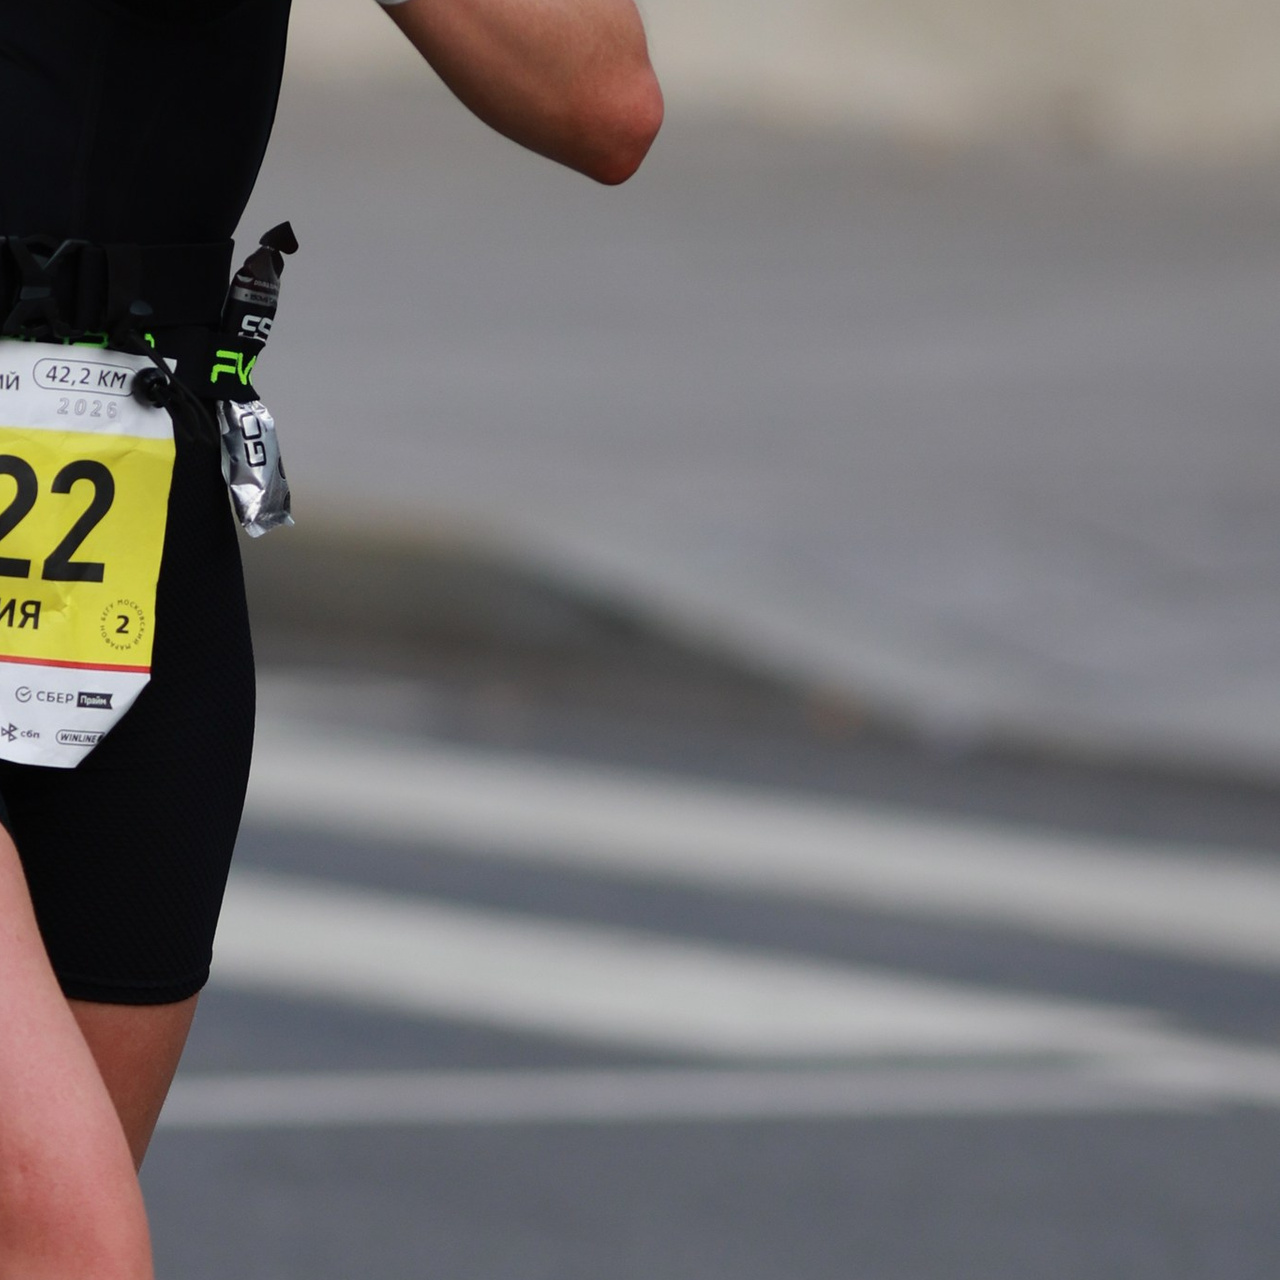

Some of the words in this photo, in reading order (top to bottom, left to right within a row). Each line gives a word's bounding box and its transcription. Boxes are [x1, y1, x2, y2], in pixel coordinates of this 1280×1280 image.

[45, 365, 91, 387] 42,2
[57, 397, 118, 418] 2026
[115, 614, 129, 634] 2
[36, 690, 75, 704] СБЕР
[80, 695, 107, 706] Прайм
[60, 732, 97, 743] WINLINE
